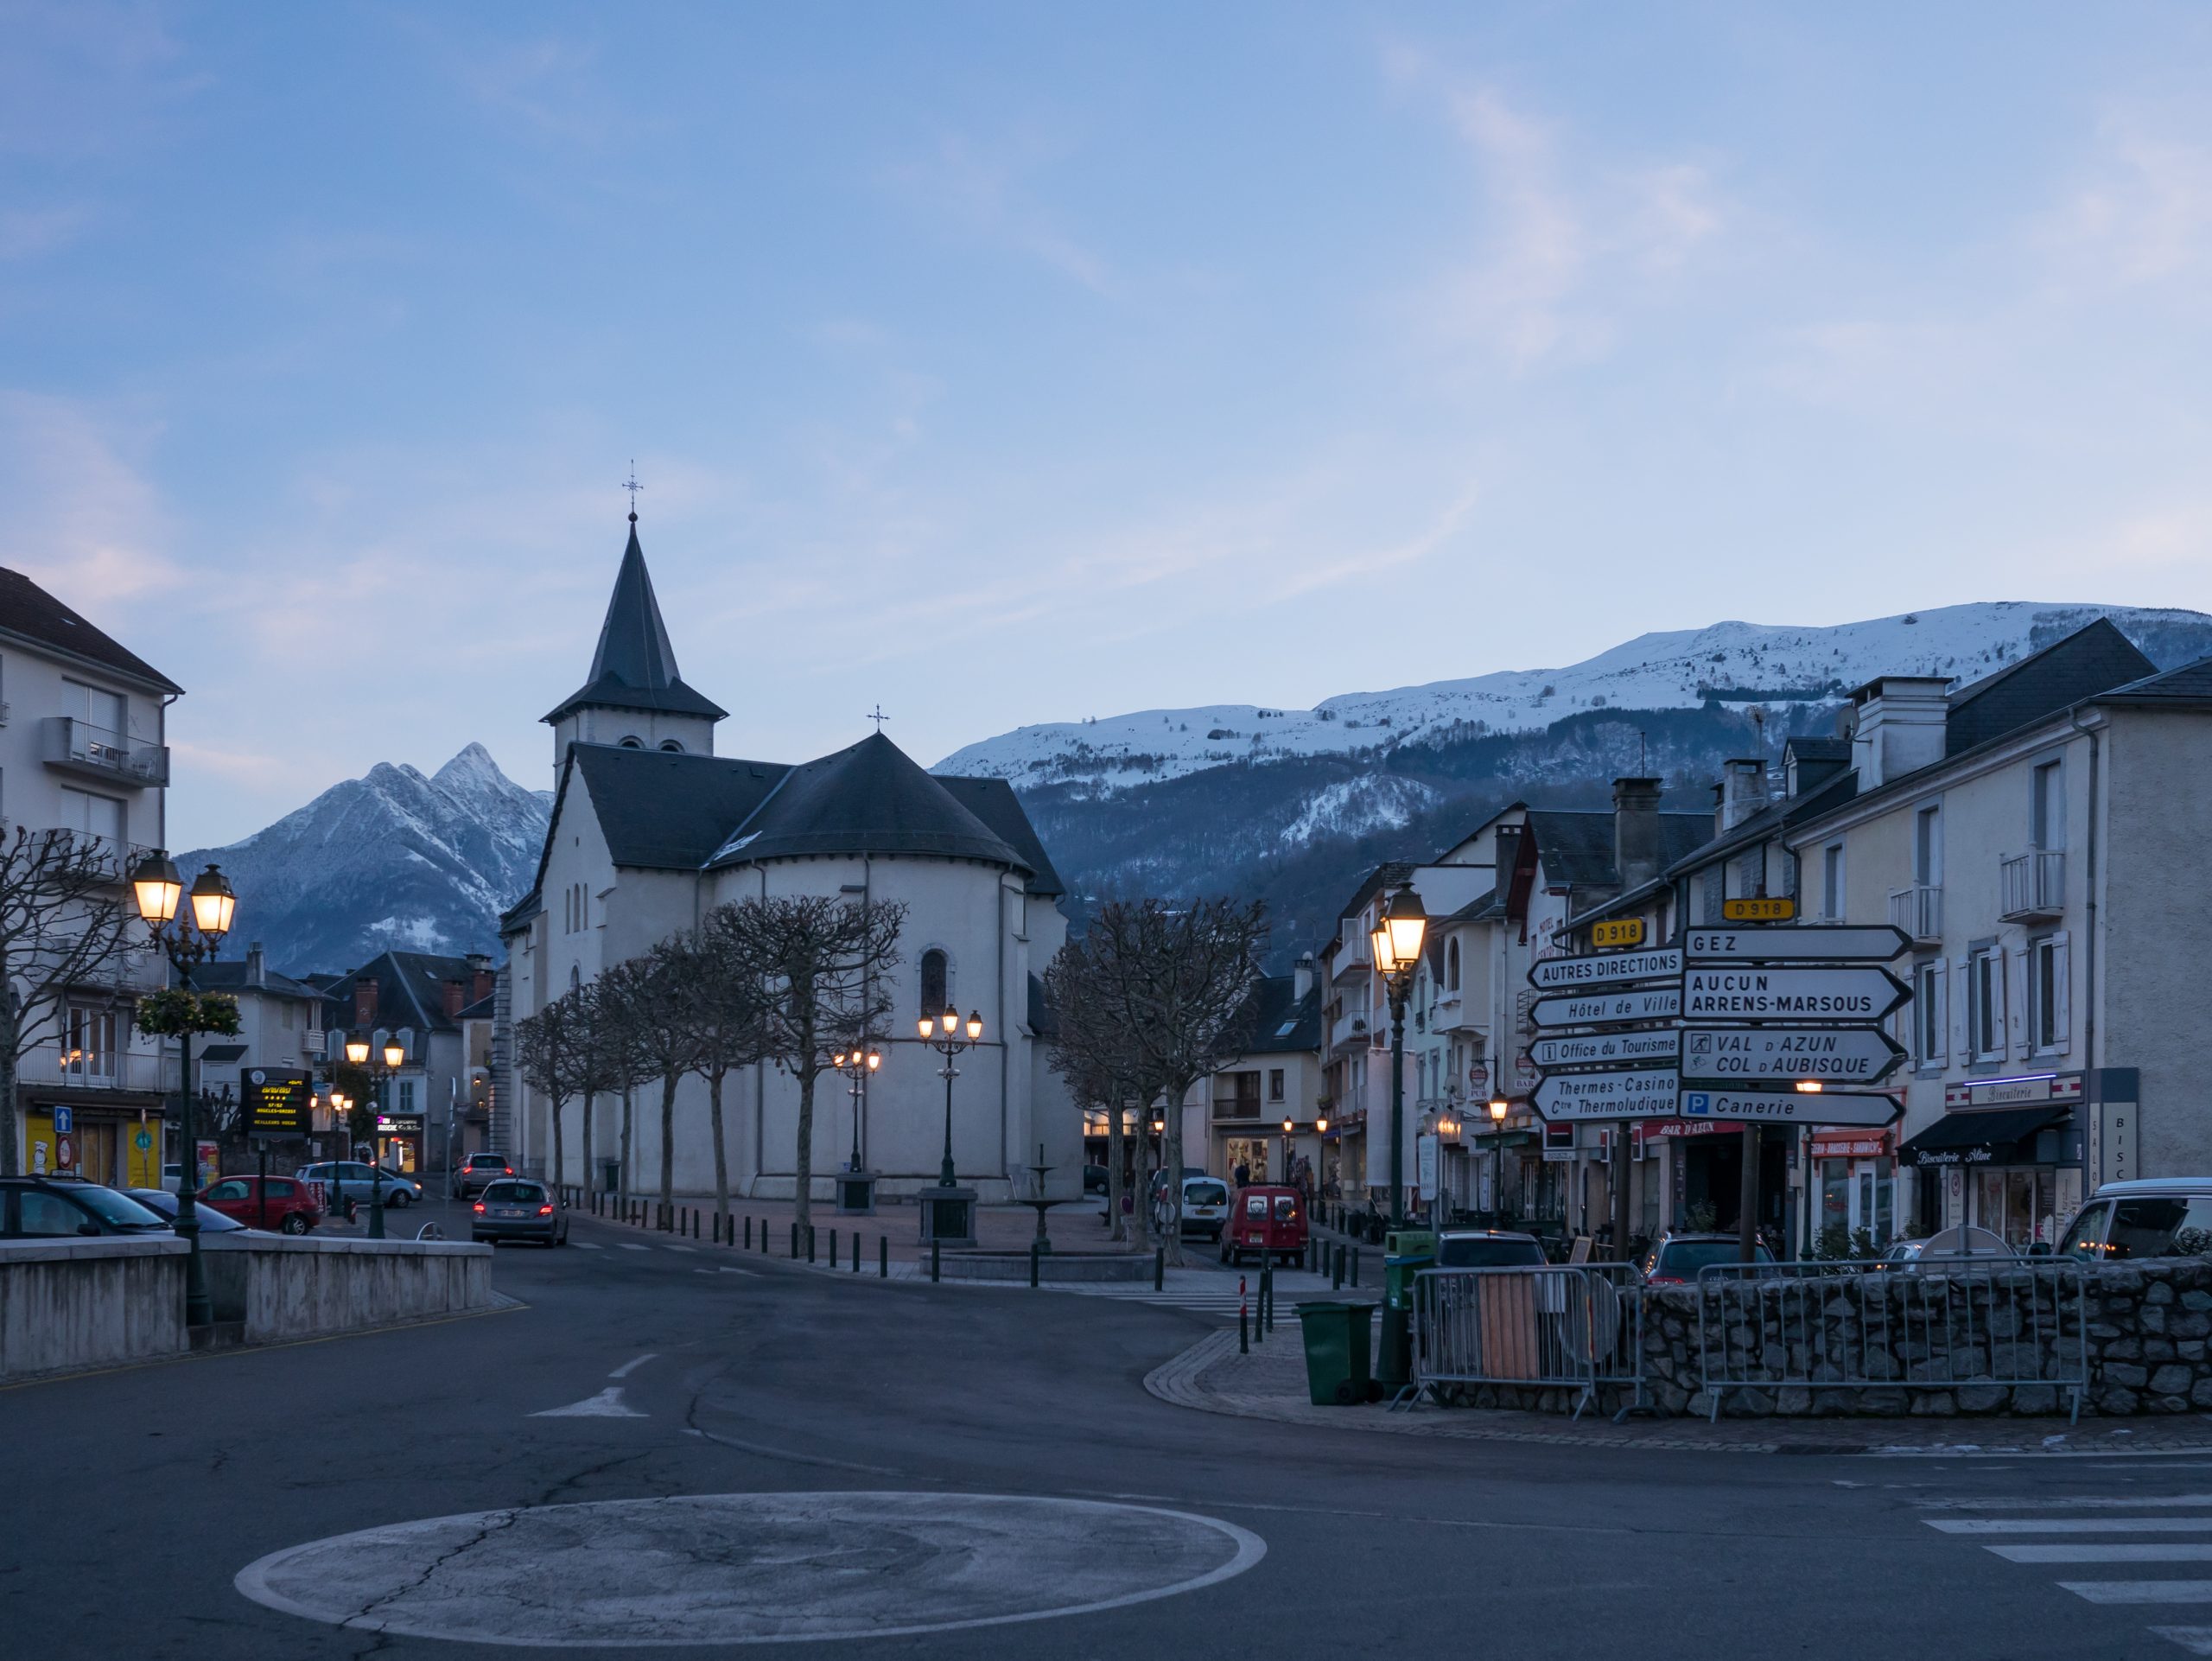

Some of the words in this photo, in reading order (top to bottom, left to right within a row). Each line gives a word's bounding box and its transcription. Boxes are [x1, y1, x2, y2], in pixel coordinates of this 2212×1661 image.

[1735, 903, 1745, 915] D
[1750, 902, 1782, 915] 918
[1596, 927, 1605, 944] D
[1611, 923, 1637, 942] 918
[1694, 936, 1736, 951] GEZ
[1542, 964, 1592, 982] AUTRES
[1598, 954, 1678, 977] DIRECTIONS
[1692, 976, 1768, 991] AUCUN
[1569, 1002, 1606, 1018] Hôtel
[1616, 1000, 1632, 1015] de
[1643, 996, 1677, 1012] Ville
[1691, 996, 1872, 1012] ARRENS-MARSOUS
[1560, 1043, 1597, 1059] Office
[1602, 1041, 1616, 1055] du
[1622, 1037, 1675, 1053] Tourisme
[1718, 1036, 1752, 1052] VAL
[1716, 1056, 1751, 1072] COL
[1987, 1085, 2032, 1103] Biscuiterie
[1579, 1097, 1675, 1114] Thermoludique
[1716, 1097, 1795, 1114] Canerie
[1659, 1124, 1681, 1135] BAR
[1916, 1150, 1960, 1166] Biscuiterie
[1965, 1148, 1992, 1162] Aline
